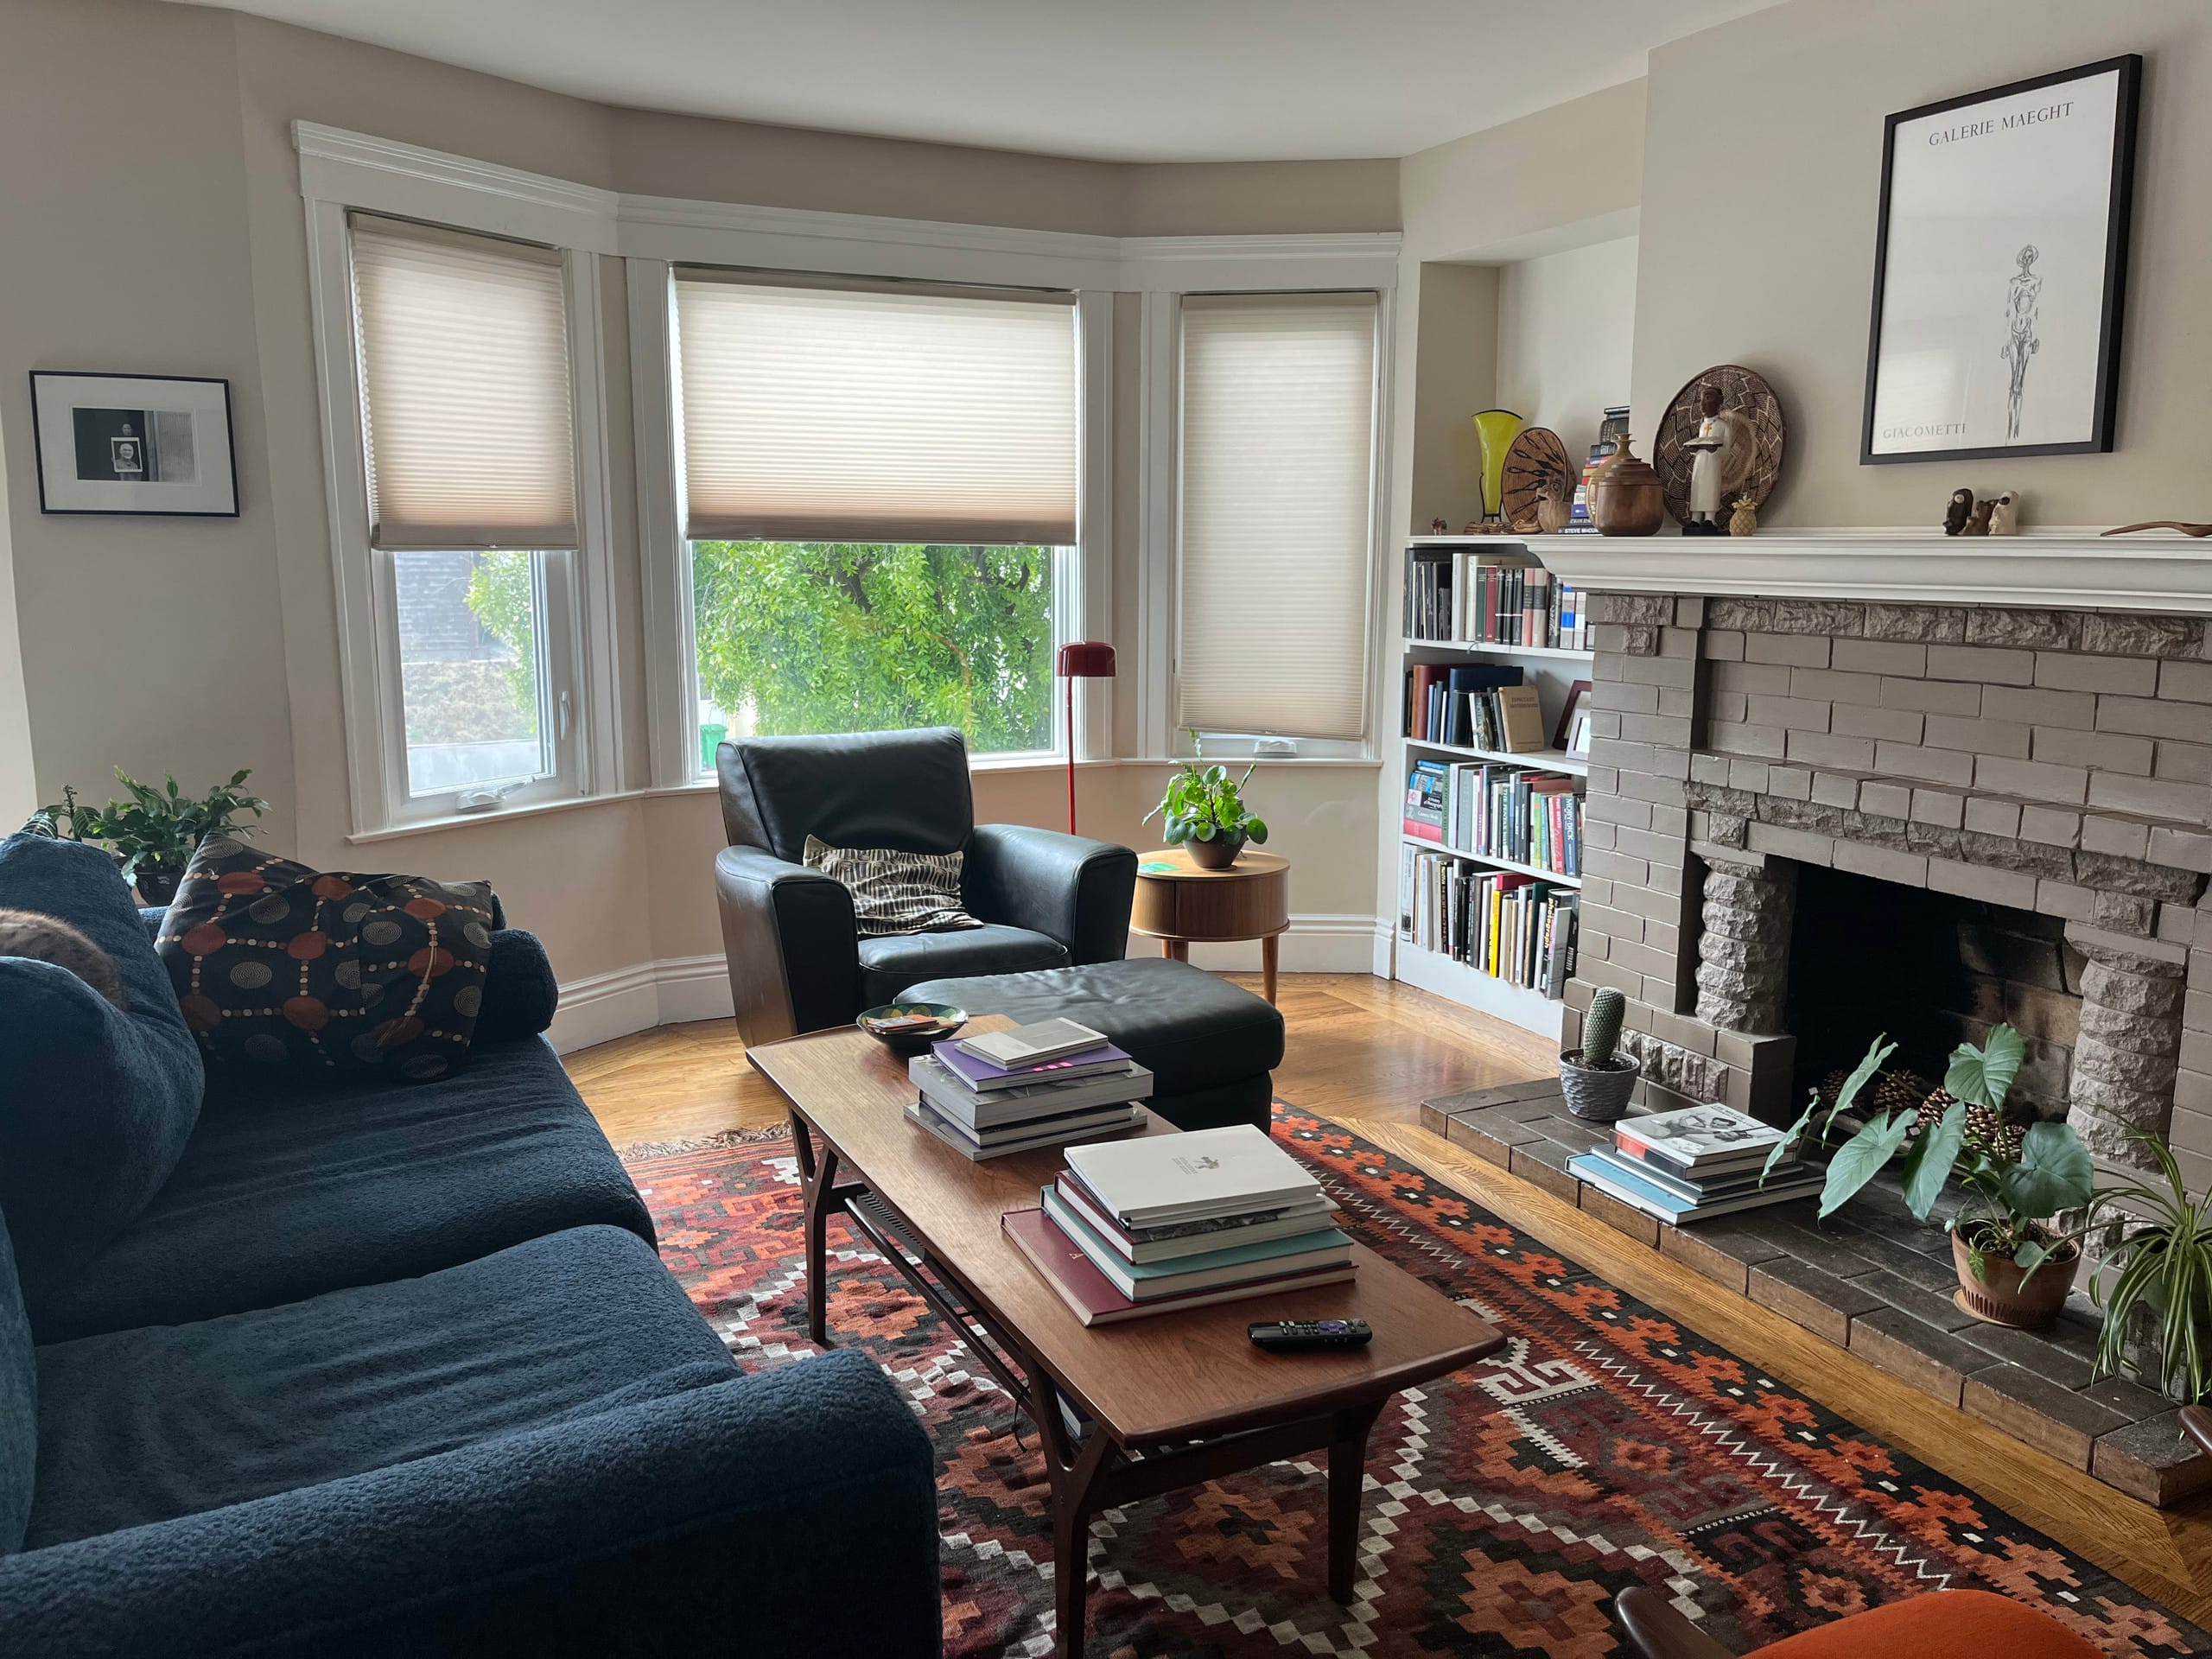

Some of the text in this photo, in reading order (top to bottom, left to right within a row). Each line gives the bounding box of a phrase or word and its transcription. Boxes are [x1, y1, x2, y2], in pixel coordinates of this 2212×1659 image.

[1929, 102, 2075, 146] GALERIE MAEGHT
[1883, 423, 1966, 439] GIACOMETTI
[1544, 897, 1554, 949] photograph
